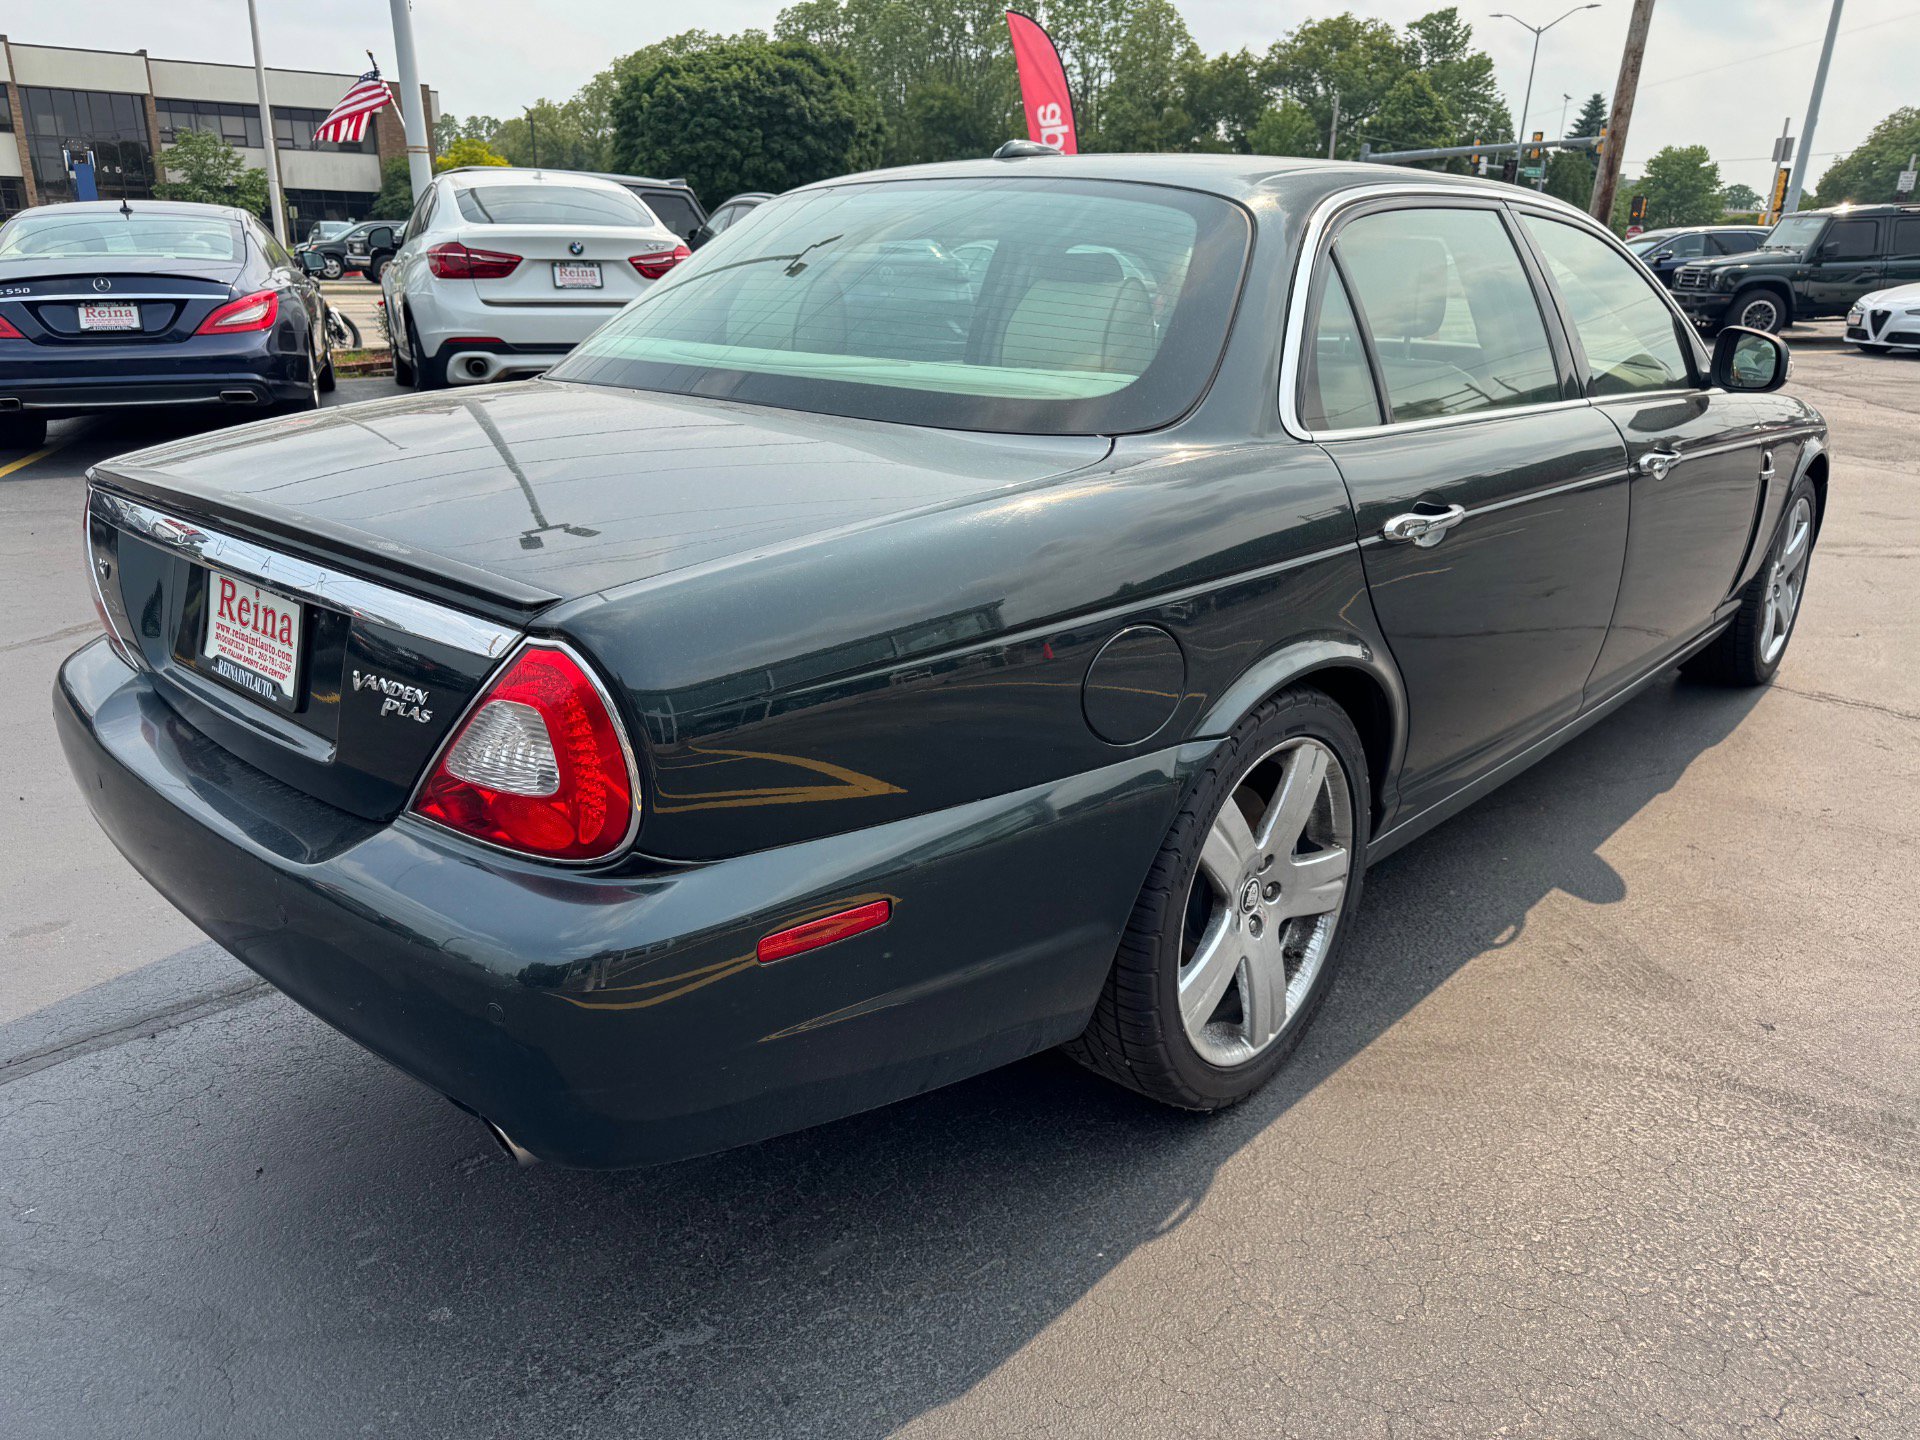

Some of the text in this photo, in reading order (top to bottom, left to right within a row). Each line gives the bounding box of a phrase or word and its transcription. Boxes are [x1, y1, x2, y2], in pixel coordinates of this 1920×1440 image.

[559, 267, 597, 277] Reina
[85, 306, 134, 318] Reina
[217, 575, 294, 649] Reina
[243, 655, 259, 669] SPORTS
[258, 663, 268, 673] CAR
[352, 669, 430, 706] VANDEN
[380, 697, 433, 723] PLAS
